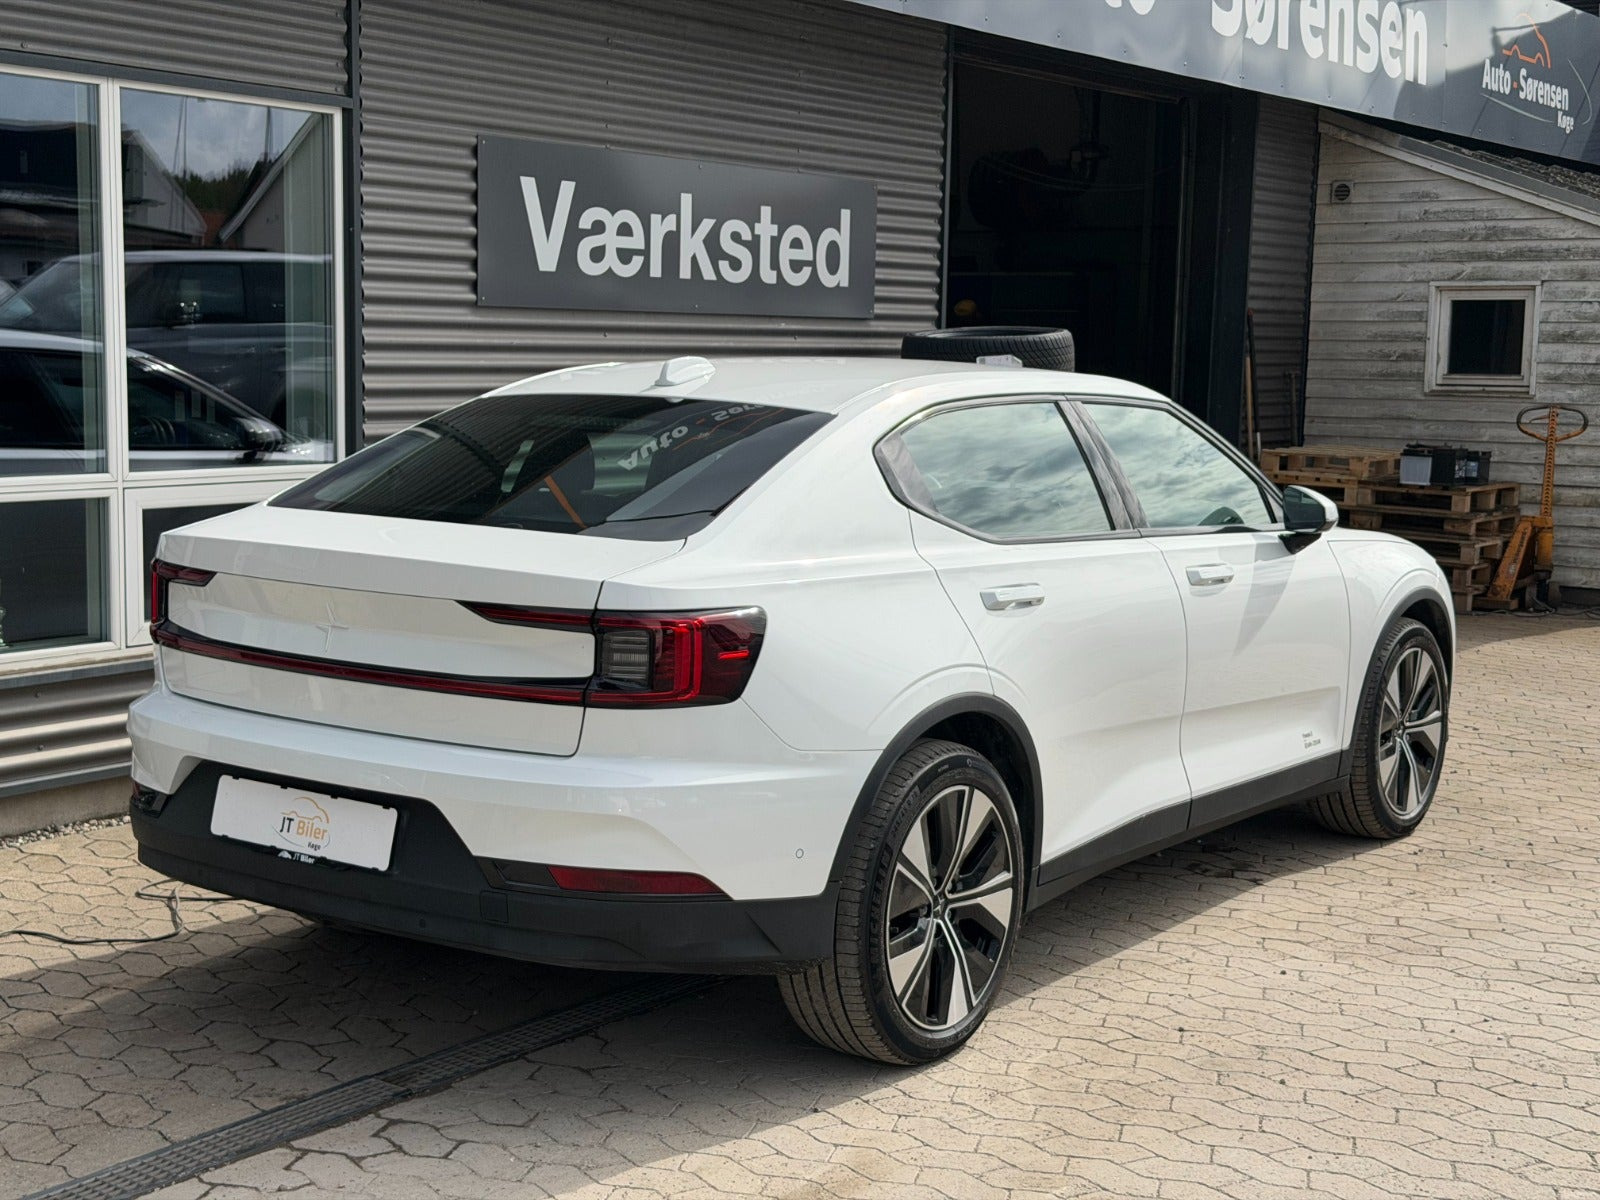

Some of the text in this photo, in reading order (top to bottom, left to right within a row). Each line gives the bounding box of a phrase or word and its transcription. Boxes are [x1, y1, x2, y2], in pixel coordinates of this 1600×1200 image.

[1482, 58, 1511, 95] Auto
[1518, 67, 1569, 111] Sørensen
[519, 175, 851, 288] Værksted
[280, 816, 328, 840] JT Biler
